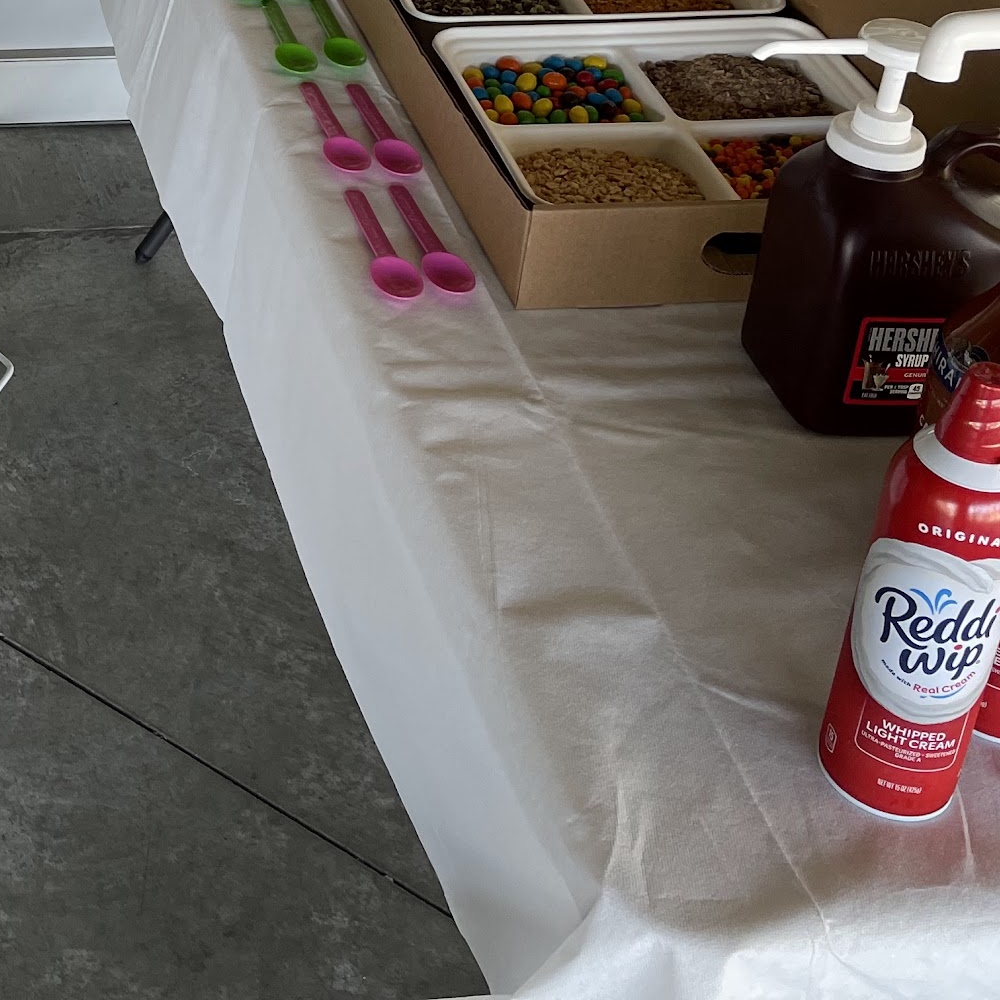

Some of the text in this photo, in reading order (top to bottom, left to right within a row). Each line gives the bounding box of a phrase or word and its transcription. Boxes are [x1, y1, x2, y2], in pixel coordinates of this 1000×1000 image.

[895, 354, 929, 367] SYRUP
[875, 587, 1000, 650] Reddi
[881, 659, 895, 676] made
[896, 676, 911, 687] with
[913, 683, 939, 694] Real
[942, 671, 976, 693] Cream
[866, 721, 955, 750] LIGHT CREAM
[882, 719, 946, 741] WHIPPED
[894, 753, 915, 762] GRADE
[925, 749, 956, 758] SWEETENED
